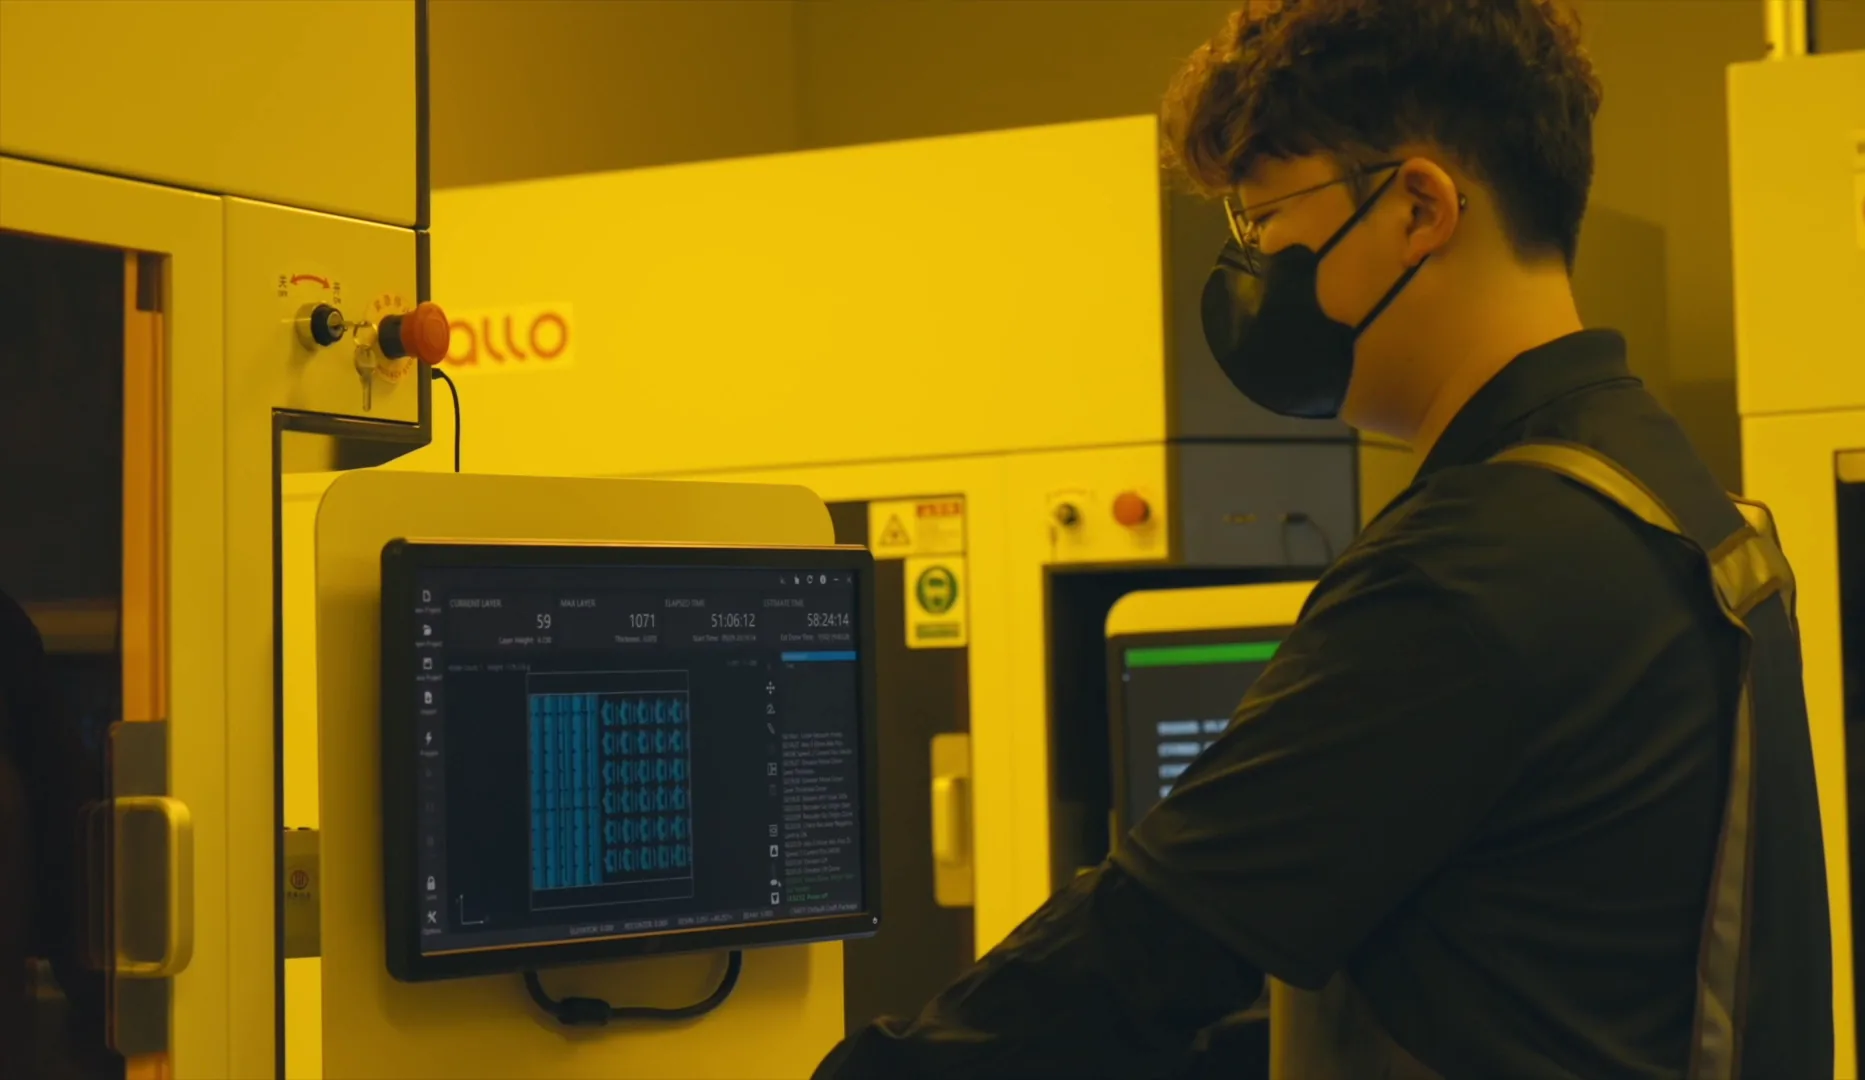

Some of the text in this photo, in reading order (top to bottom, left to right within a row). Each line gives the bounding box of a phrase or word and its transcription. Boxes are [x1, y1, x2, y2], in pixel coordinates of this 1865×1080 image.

[481, 598, 503, 609] LAYER
[560, 598, 597, 609] MAX LAYER
[690, 598, 705, 608] TIME
[536, 613, 552, 629] 59
[629, 613, 655, 629] 1071
[711, 613, 756, 628] 51:06:12
[807, 612, 850, 628] 58:24:14
